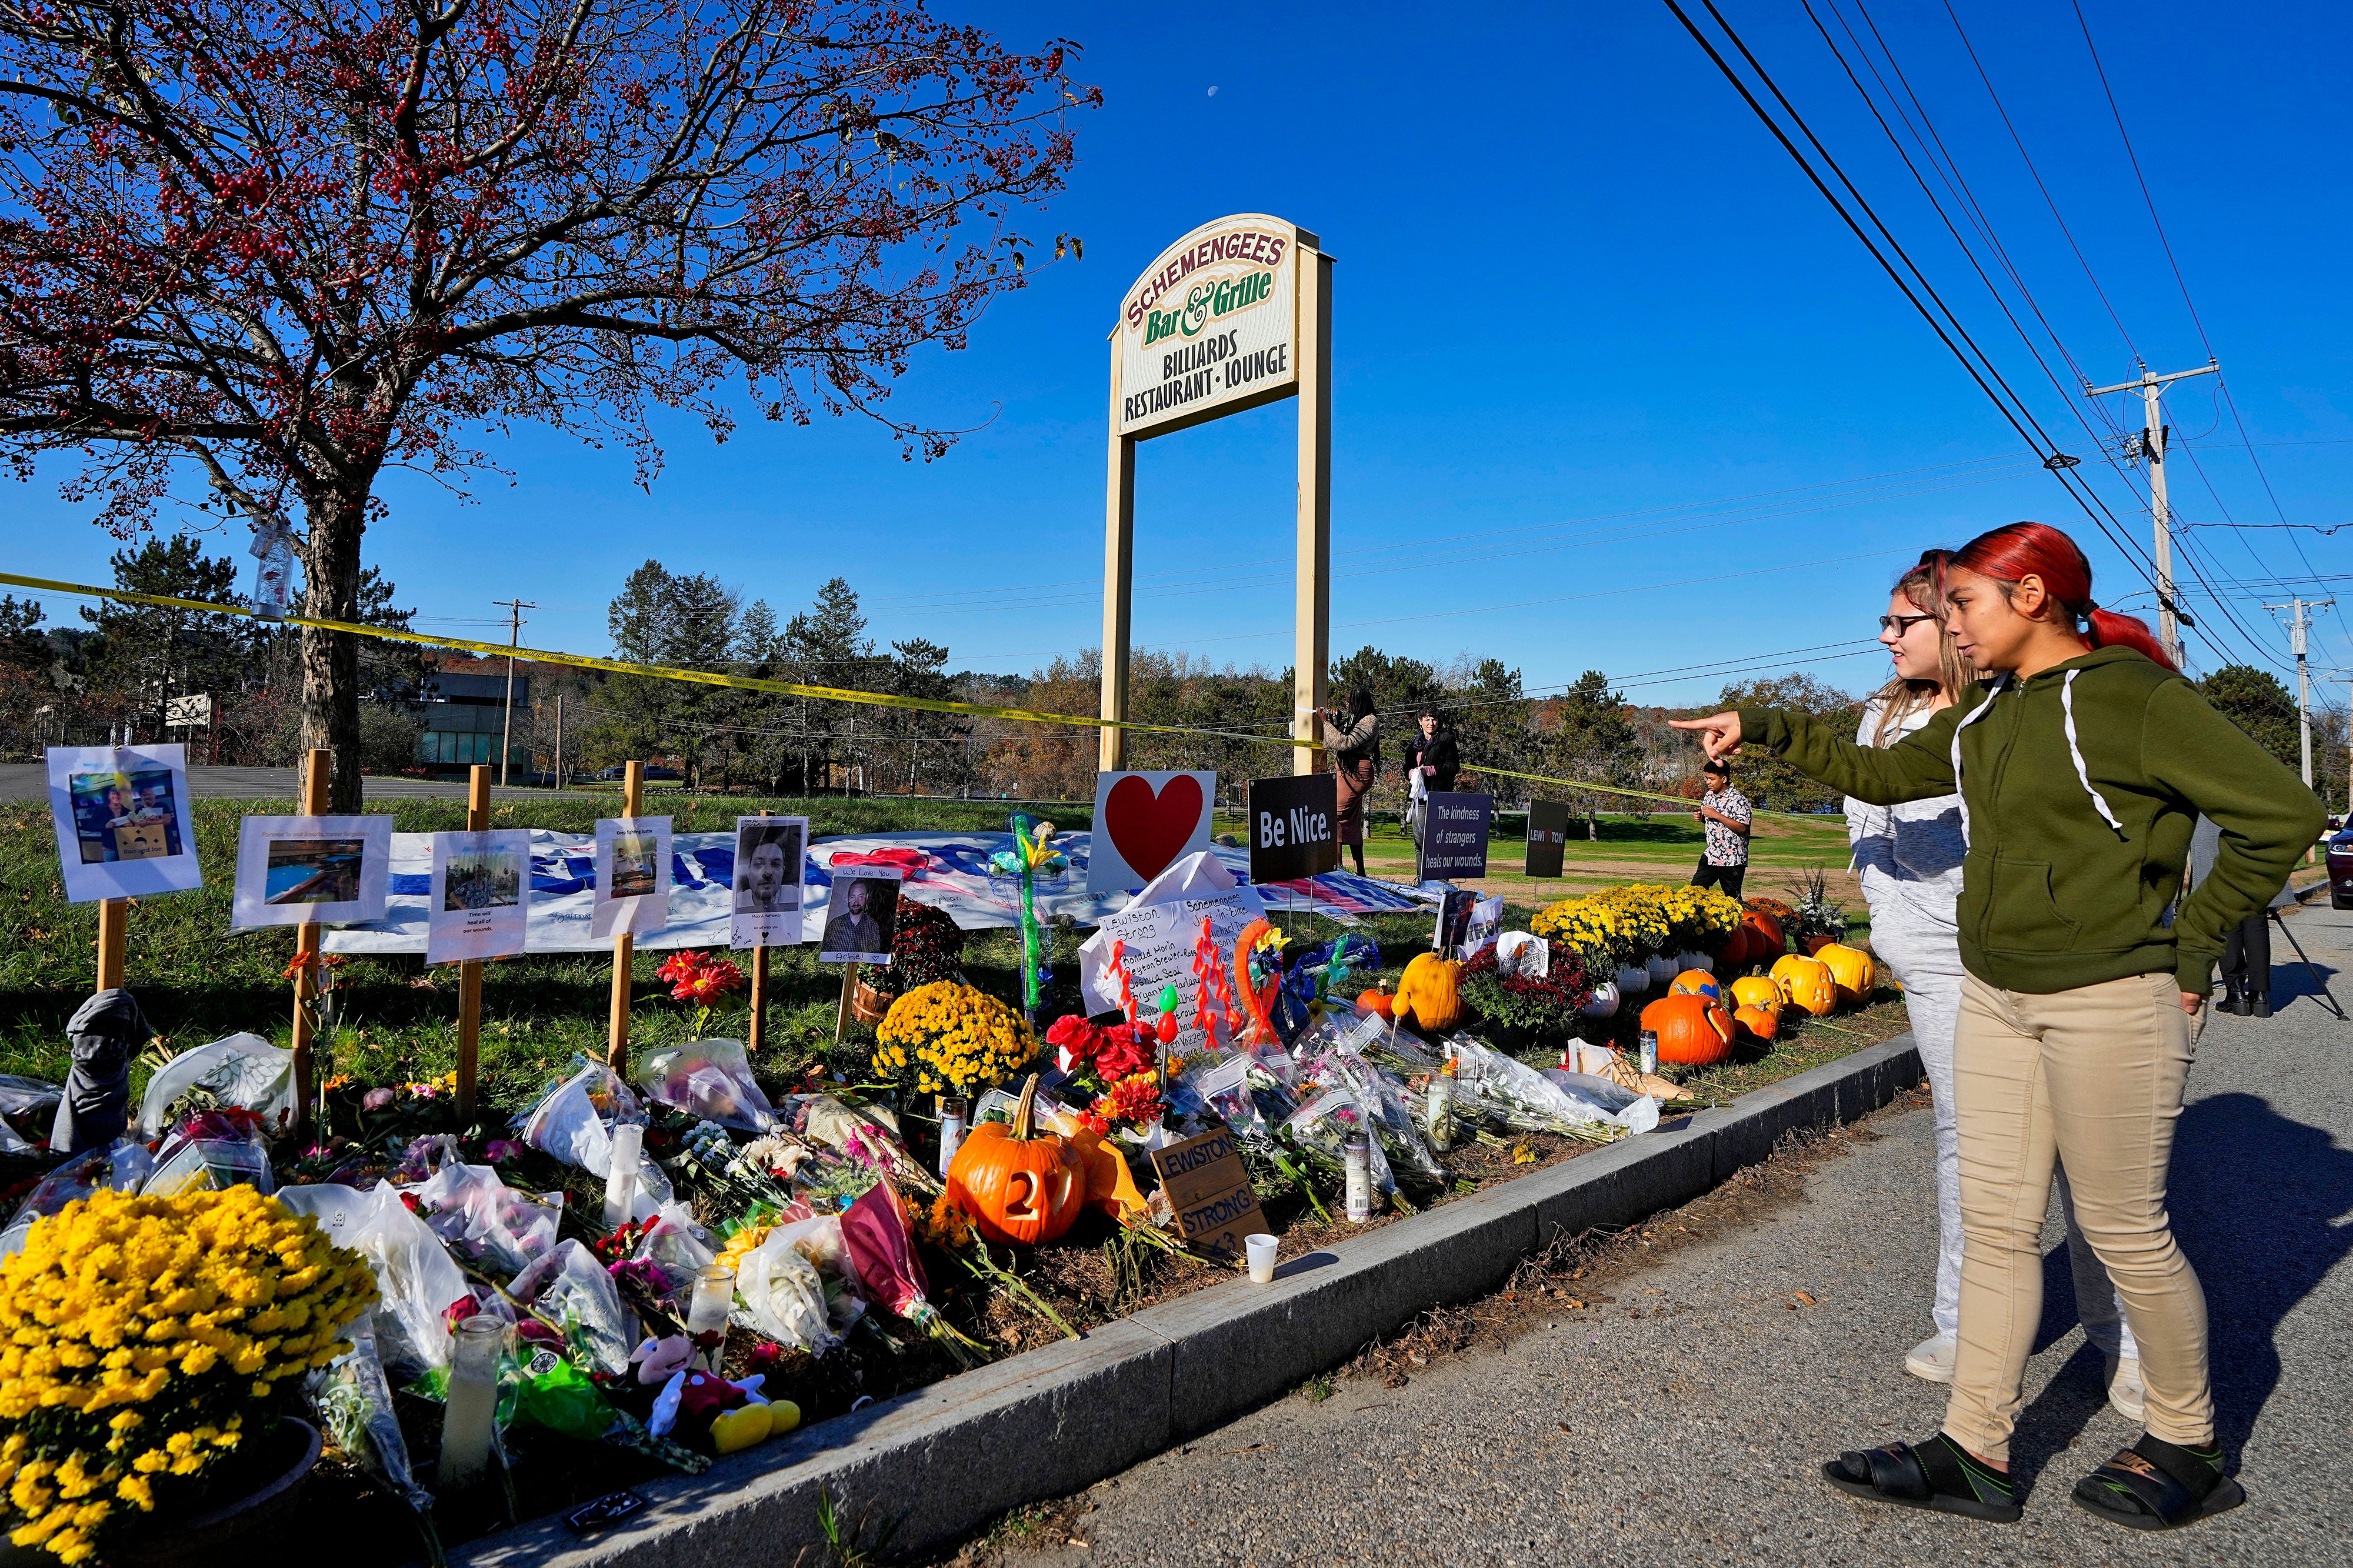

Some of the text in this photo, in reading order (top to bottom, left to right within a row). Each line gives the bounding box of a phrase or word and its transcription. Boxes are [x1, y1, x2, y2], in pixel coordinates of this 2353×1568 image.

[1128, 232, 1285, 328] SCHEMENGEES
[1145, 272, 1271, 345] Bar & Grille
[1164, 328, 1237, 380] BILLIARDS
[1125, 343, 1287, 422] RESTAURANT LOUNGE
[77, 584, 152, 600] DO NOT CROSS
[1438, 805, 1479, 820] The kindness
[1260, 805, 1331, 849] Be Nice.
[1436, 829, 1476, 847] of strangers
[1425, 853, 1482, 868] heals our wounds.
[859, 868, 874, 876] Love
[1187, 893, 1242, 912] Schemengees
[1117, 924, 1156, 943] Strong
[836, 952, 864, 960] Artie!
[1120, 940, 1175, 966] Ronald Morin
[1129, 975, 1162, 990] Joshua
[1158, 1132, 1232, 1179] LEWISTON
[1181, 1182, 1255, 1233] STRONG!
[2119, 1450, 2157, 1475] NIKE
